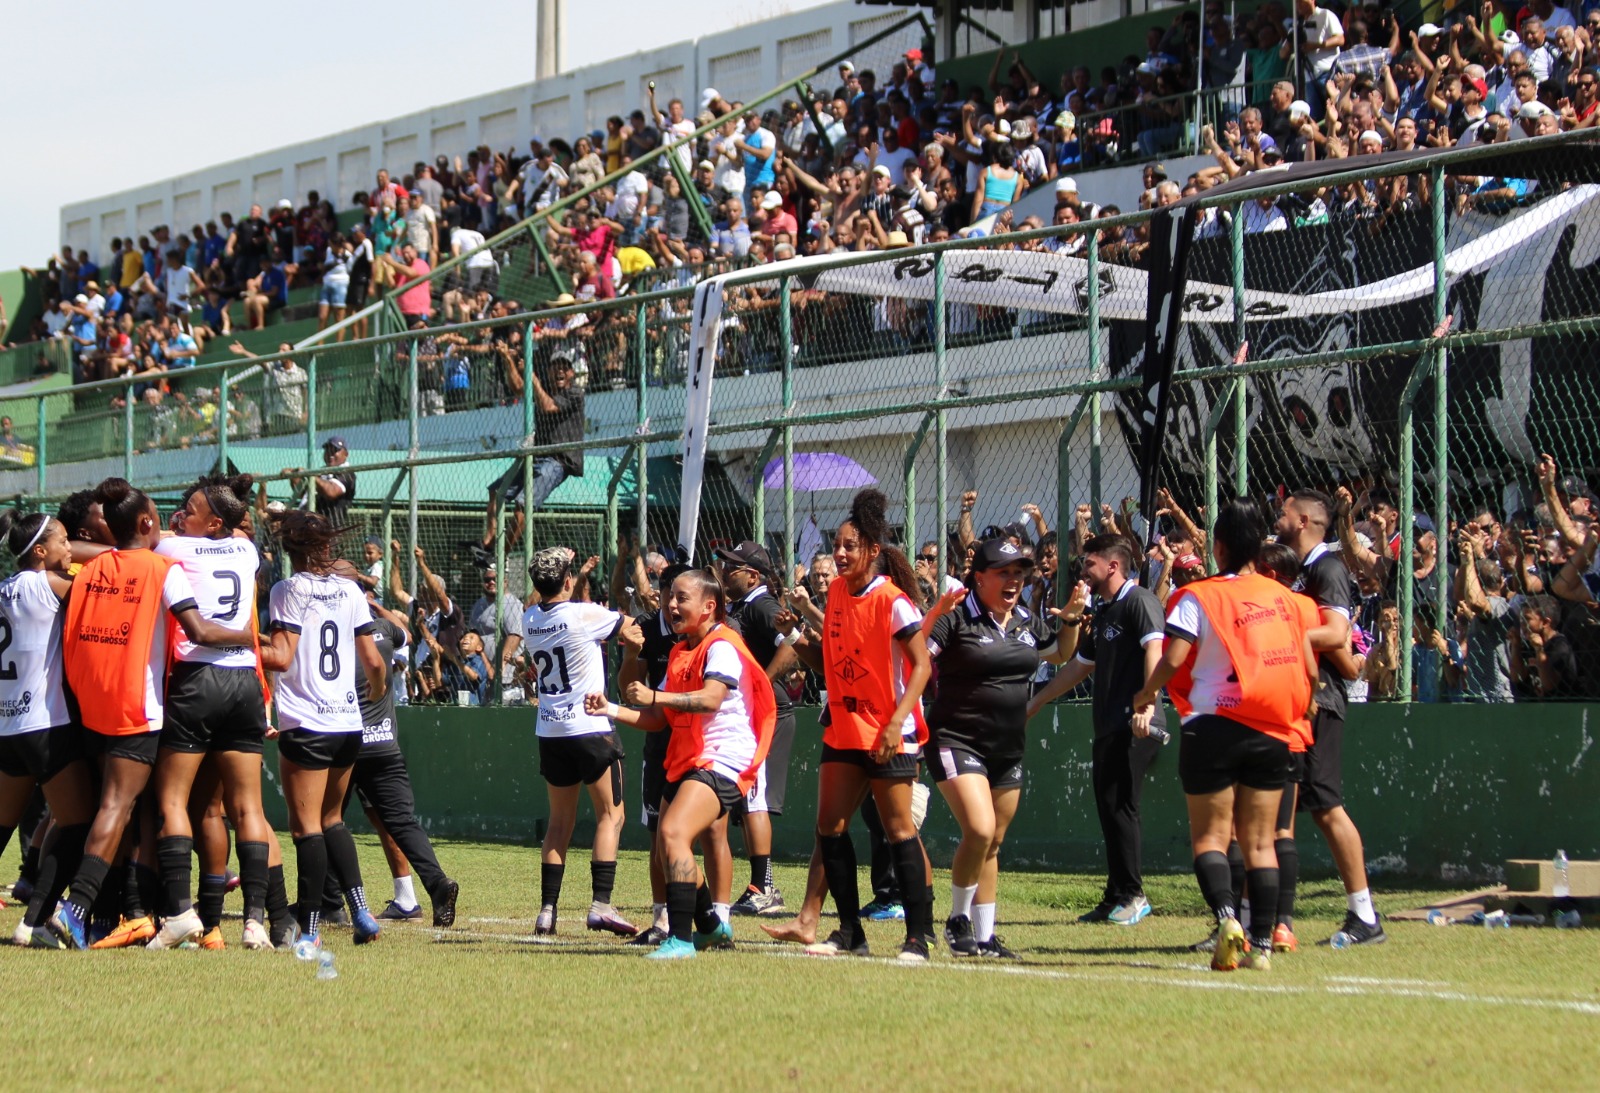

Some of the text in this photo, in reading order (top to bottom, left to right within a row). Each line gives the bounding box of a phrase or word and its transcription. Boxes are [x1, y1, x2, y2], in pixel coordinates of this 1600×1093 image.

[195, 547, 234, 556] Unimed
[212, 569, 241, 621] 3
[528, 624, 556, 635] Unimed
[80, 633, 128, 646] MATO GROSSO
[319, 620, 340, 681] 8
[533, 646, 573, 695] 21
[362, 732, 394, 744] GROSSO
